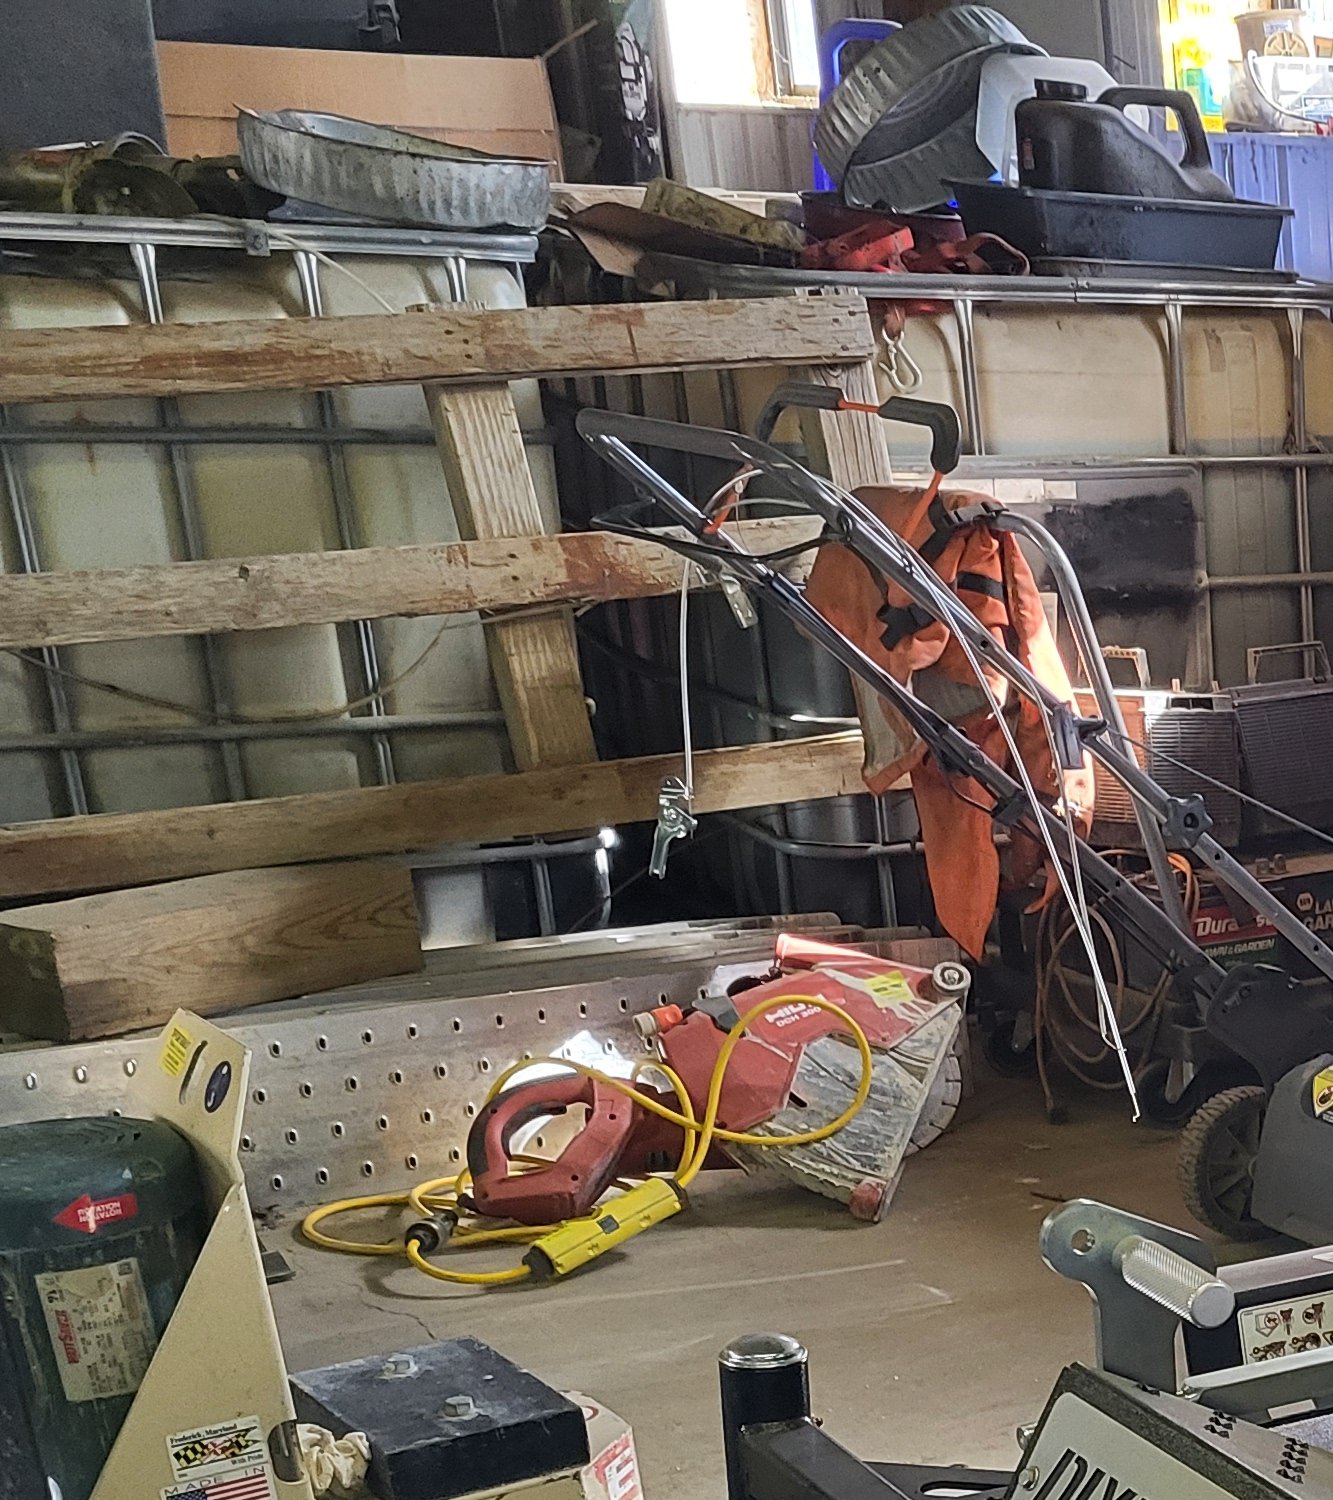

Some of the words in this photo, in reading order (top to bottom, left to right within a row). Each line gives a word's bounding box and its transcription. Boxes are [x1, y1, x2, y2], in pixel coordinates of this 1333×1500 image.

[1201, 944, 1228, 958] AWN
[1234, 938, 1275, 954] GARDEN
[776, 1015, 800, 1027] DCH
[802, 1005, 822, 1018] 300
[205, 1423, 237, 1436] Maryland
[244, 1466, 265, 1476] IN
